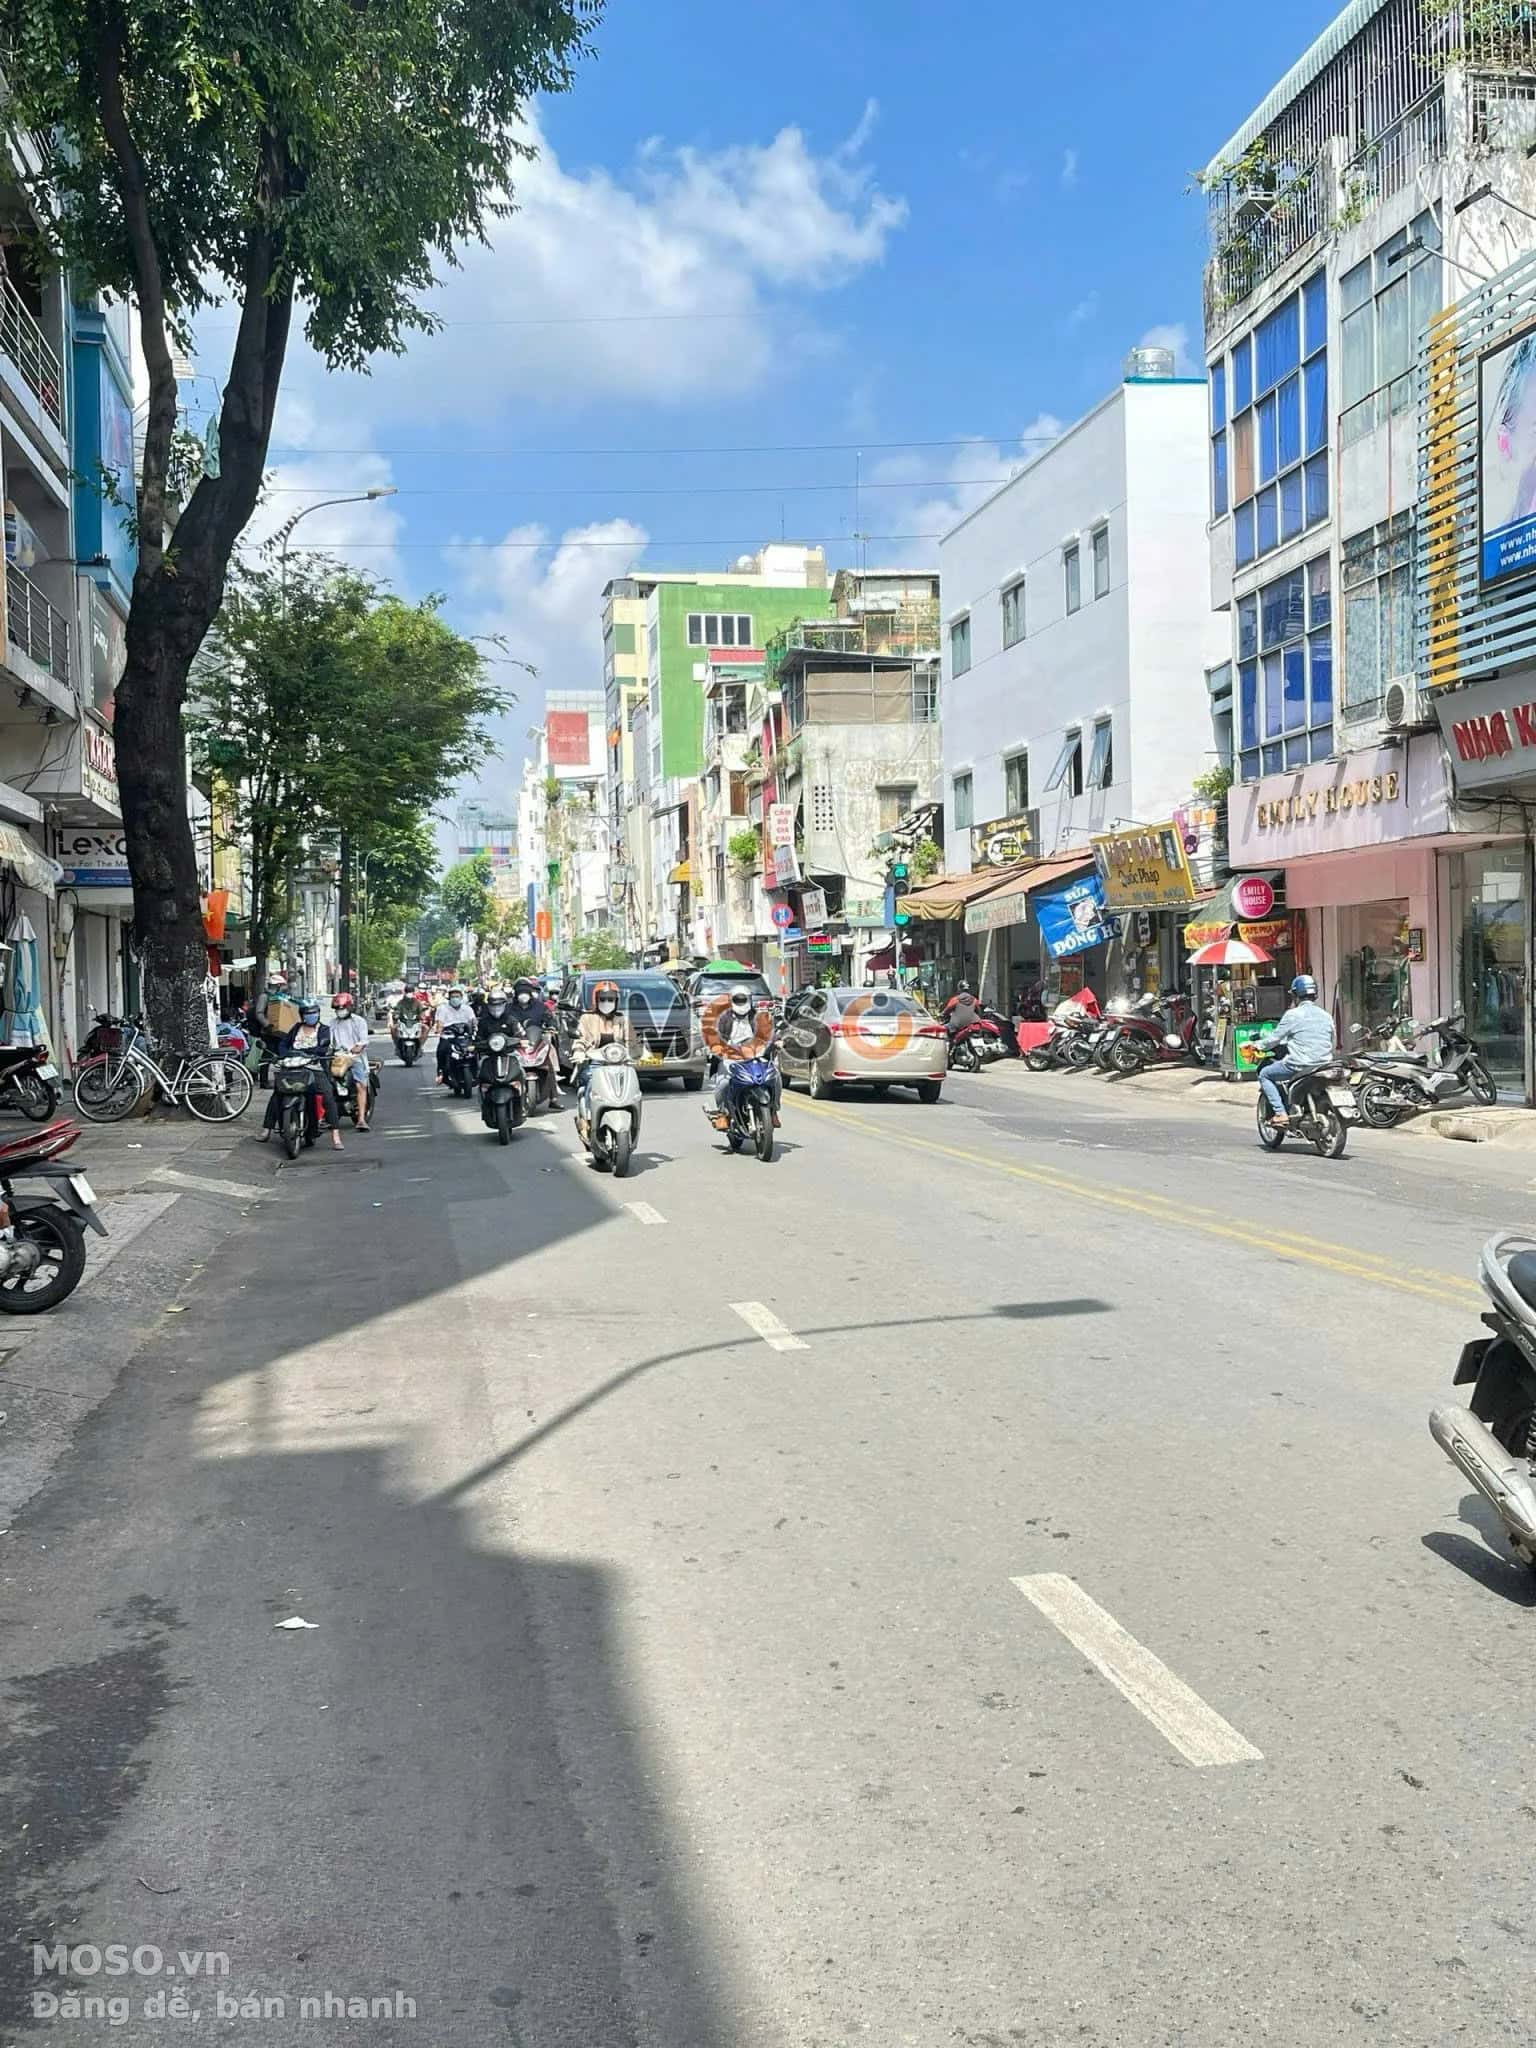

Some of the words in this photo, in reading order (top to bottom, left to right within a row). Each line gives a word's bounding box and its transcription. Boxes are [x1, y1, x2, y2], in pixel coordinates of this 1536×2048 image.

[1512, 701, 1536, 748] K
[1257, 791, 1318, 828] EMILY
[1325, 771, 1400, 814] HOUSE
[1243, 885, 1265, 896] EMILY
[1243, 895, 1267, 906] HOUSE
